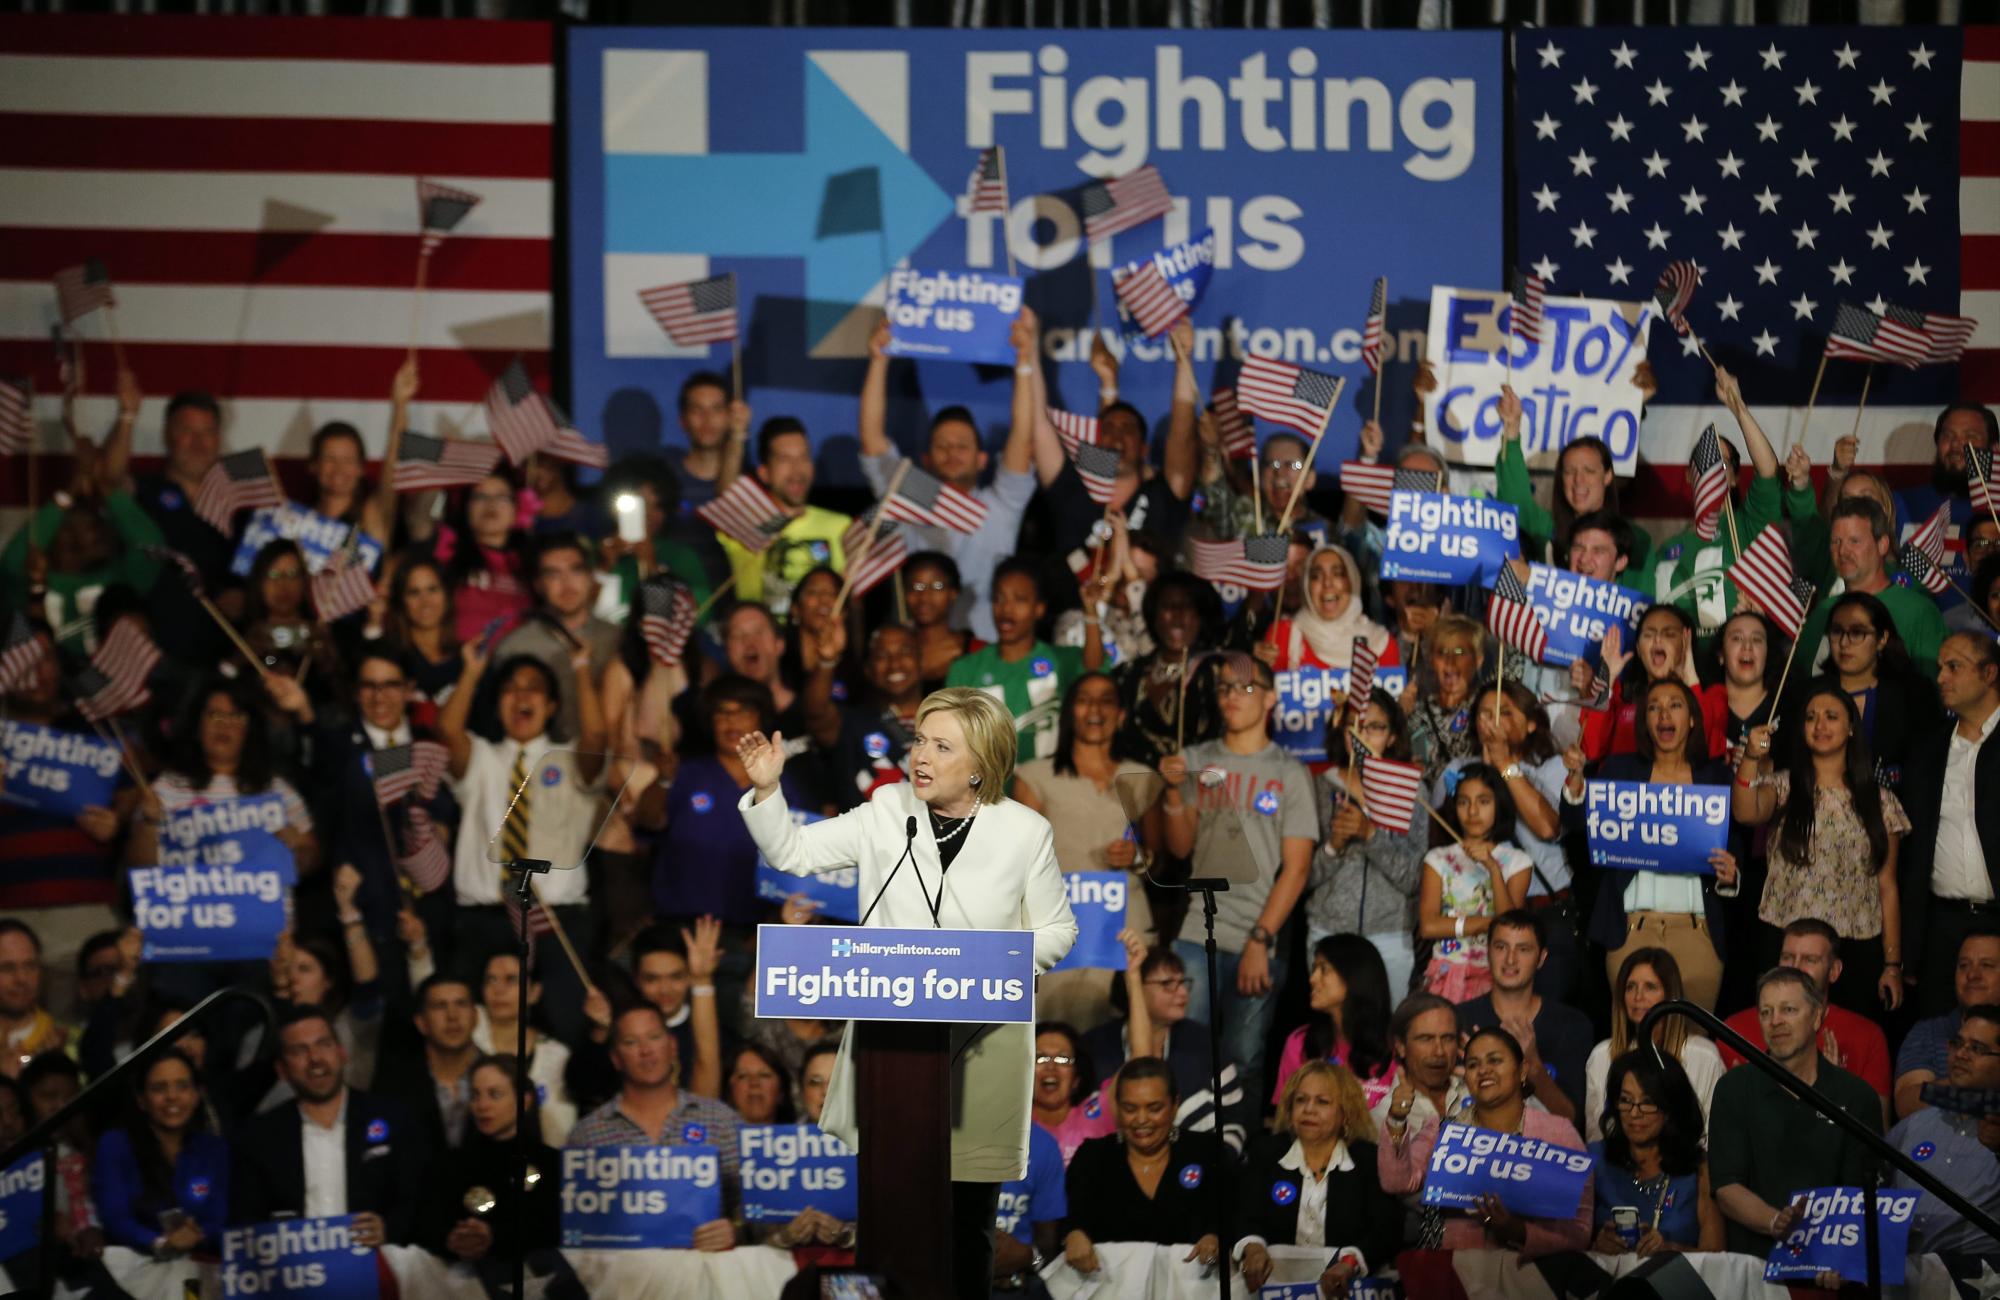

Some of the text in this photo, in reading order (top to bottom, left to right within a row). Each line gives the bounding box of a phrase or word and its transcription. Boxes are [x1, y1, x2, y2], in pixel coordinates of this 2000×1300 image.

[966, 44, 1476, 182] Fighting
[890, 269, 1022, 314] Fighting
[934, 307, 975, 333] us
[1390, 491, 1518, 542] Fighting
[1386, 521, 1479, 559] for us
[1526, 563, 1650, 634] Fighting
[1569, 612, 1607, 643] us
[0, 720, 122, 778] ighting
[28, 763, 71, 793] us
[1587, 780, 1727, 826] Fighting
[1586, 810, 1680, 847] for us
[129, 865, 281, 903] Fighting
[134, 898, 237, 930] for us
[852, 942, 961, 957] hillaryclinton.com
[766, 965, 1024, 1007] Fighting for us
[1431, 1145, 1534, 1182] for us
[1439, 1123, 1593, 1173] Fighting
[562, 1147, 719, 1189] Fighting
[739, 1158, 847, 1191] for us
[561, 1181, 668, 1215] for us
[1821, 1223, 1861, 1247] us
[221, 1262, 327, 1297] for us
